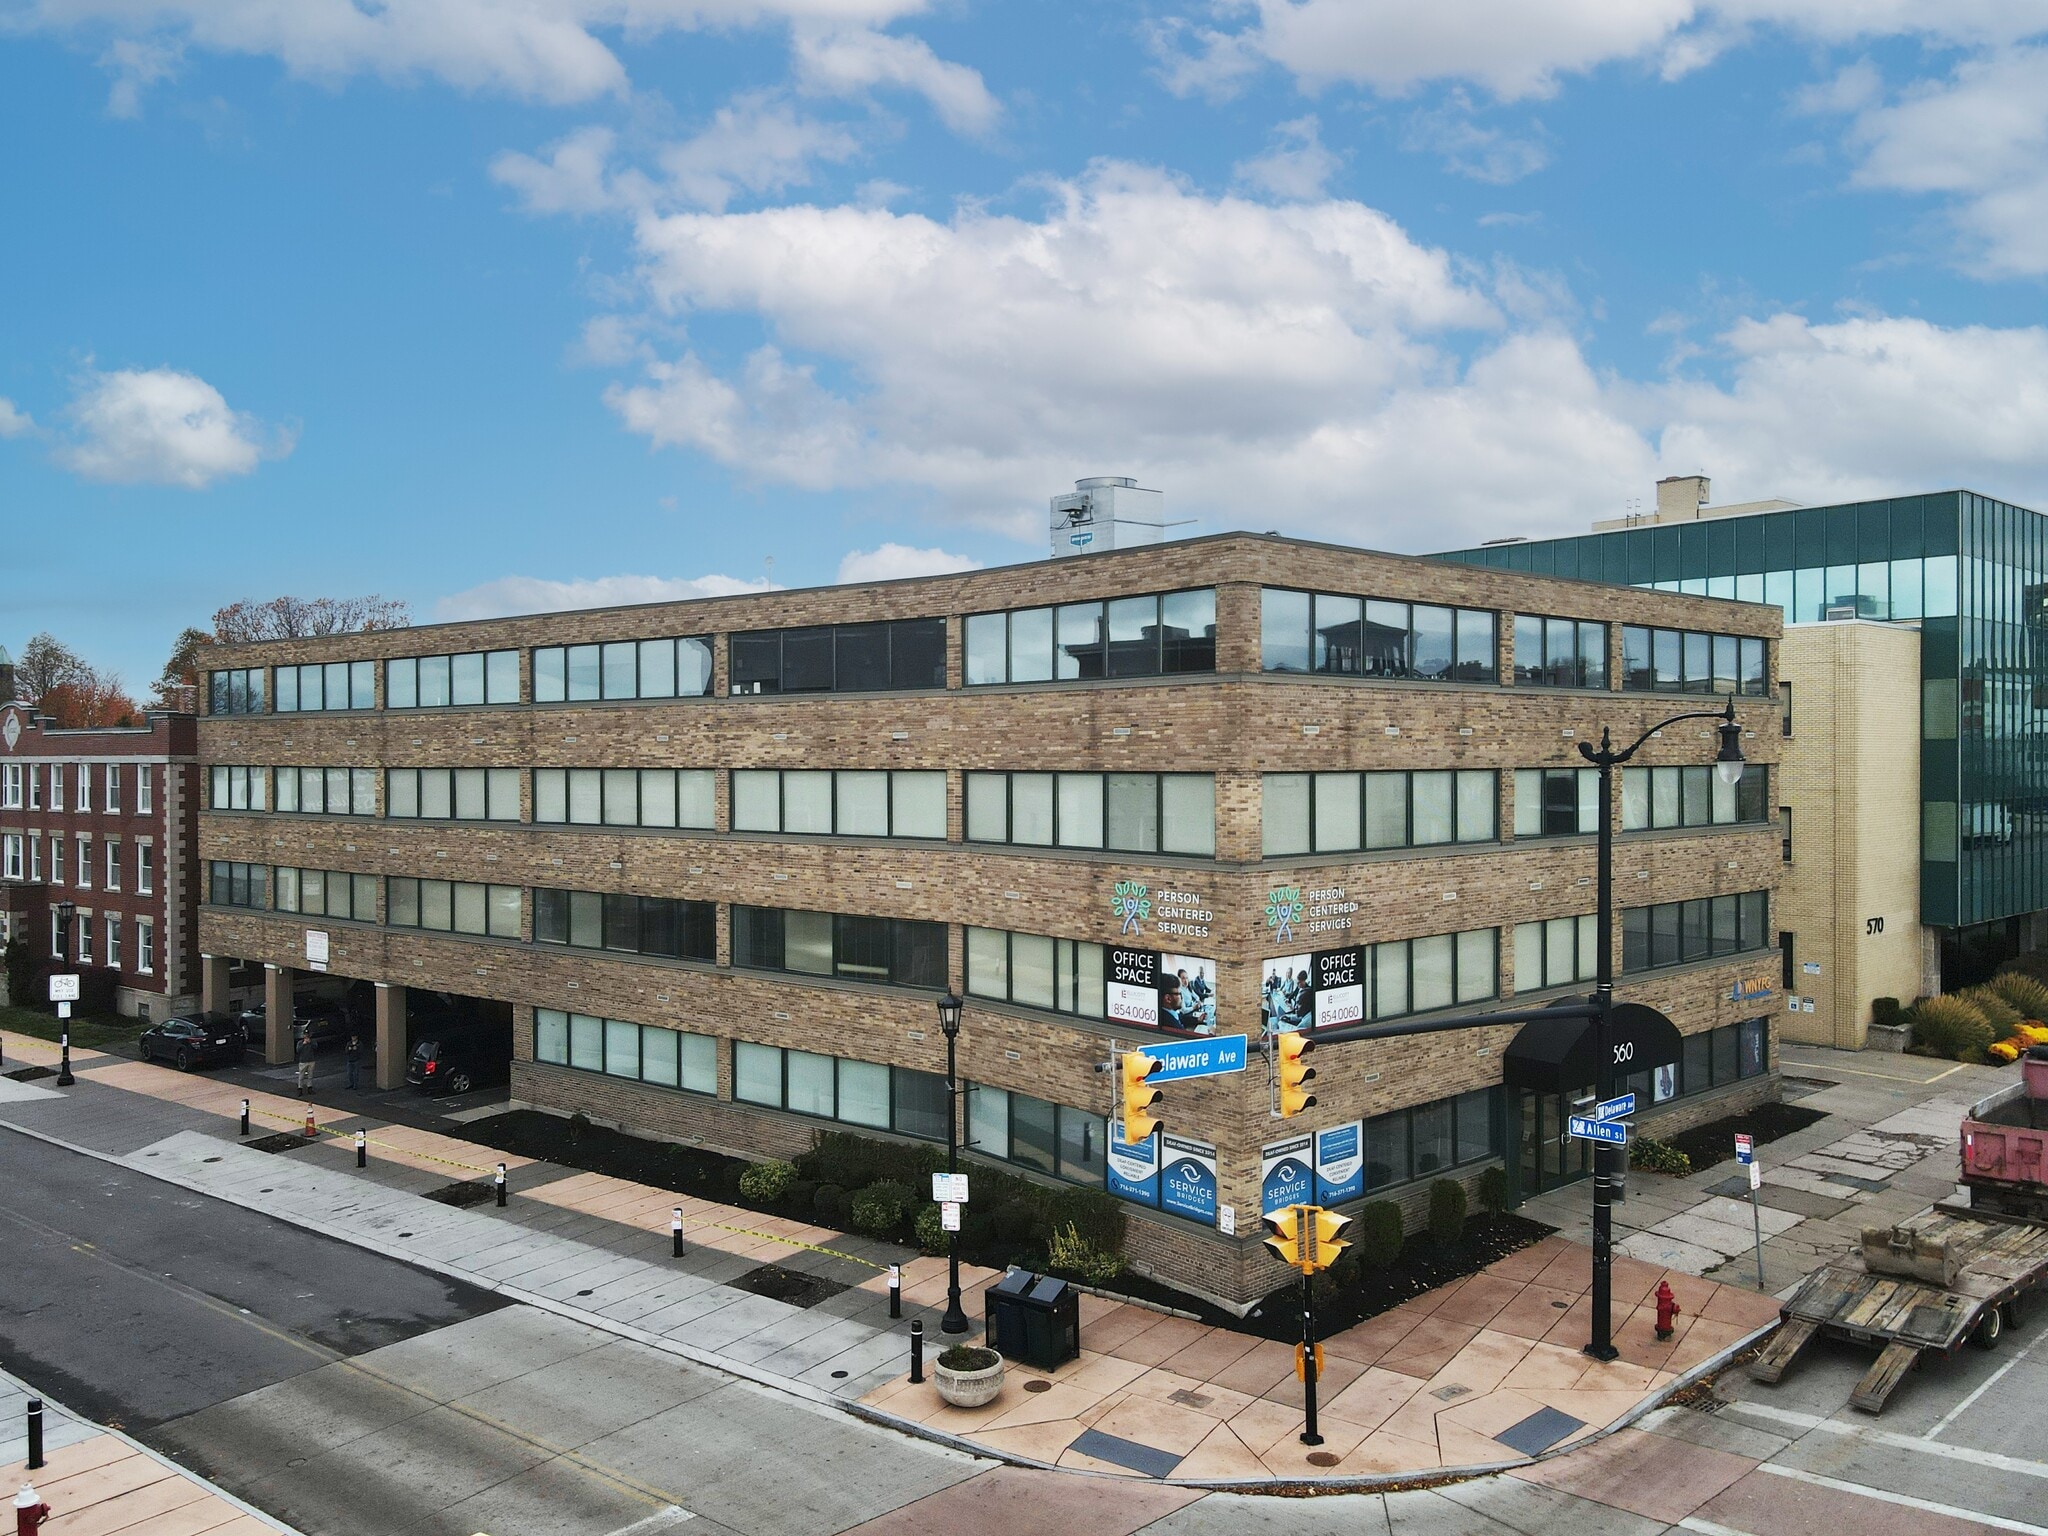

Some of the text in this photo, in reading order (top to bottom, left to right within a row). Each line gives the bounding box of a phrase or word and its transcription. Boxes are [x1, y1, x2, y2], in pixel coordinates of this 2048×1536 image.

[1157, 890, 1200, 904] PERSON
[1309, 888, 1345, 901] PERSON
[1157, 906, 1213, 922] CENTERED
[1310, 902, 1355, 917] CENTERED
[1158, 921, 1208, 938] SERVICES
[1309, 917, 1352, 932] SERVICES
[1866, 916, 1884, 935] 570
[1112, 950, 1154, 969] OFFICE
[1320, 952, 1357, 971] OFFICE
[1115, 966, 1152, 985] SPACE
[1322, 968, 1355, 987] SPACE
[1218, 1050, 1236, 1064] Ave
[1613, 1042, 1634, 1064] 560
[1604, 1102, 1627, 1117] Delaware
[1586, 1123, 1623, 1140] Allen St
[1193, 1146, 1205, 1155] SINCE
[1169, 1178, 1213, 1200] SERVICE
[1268, 1180, 1306, 1200] SERVICE
[1176, 1191, 1206, 1205] BRIDGES
[1274, 1192, 1300, 1205] BRIDGES
